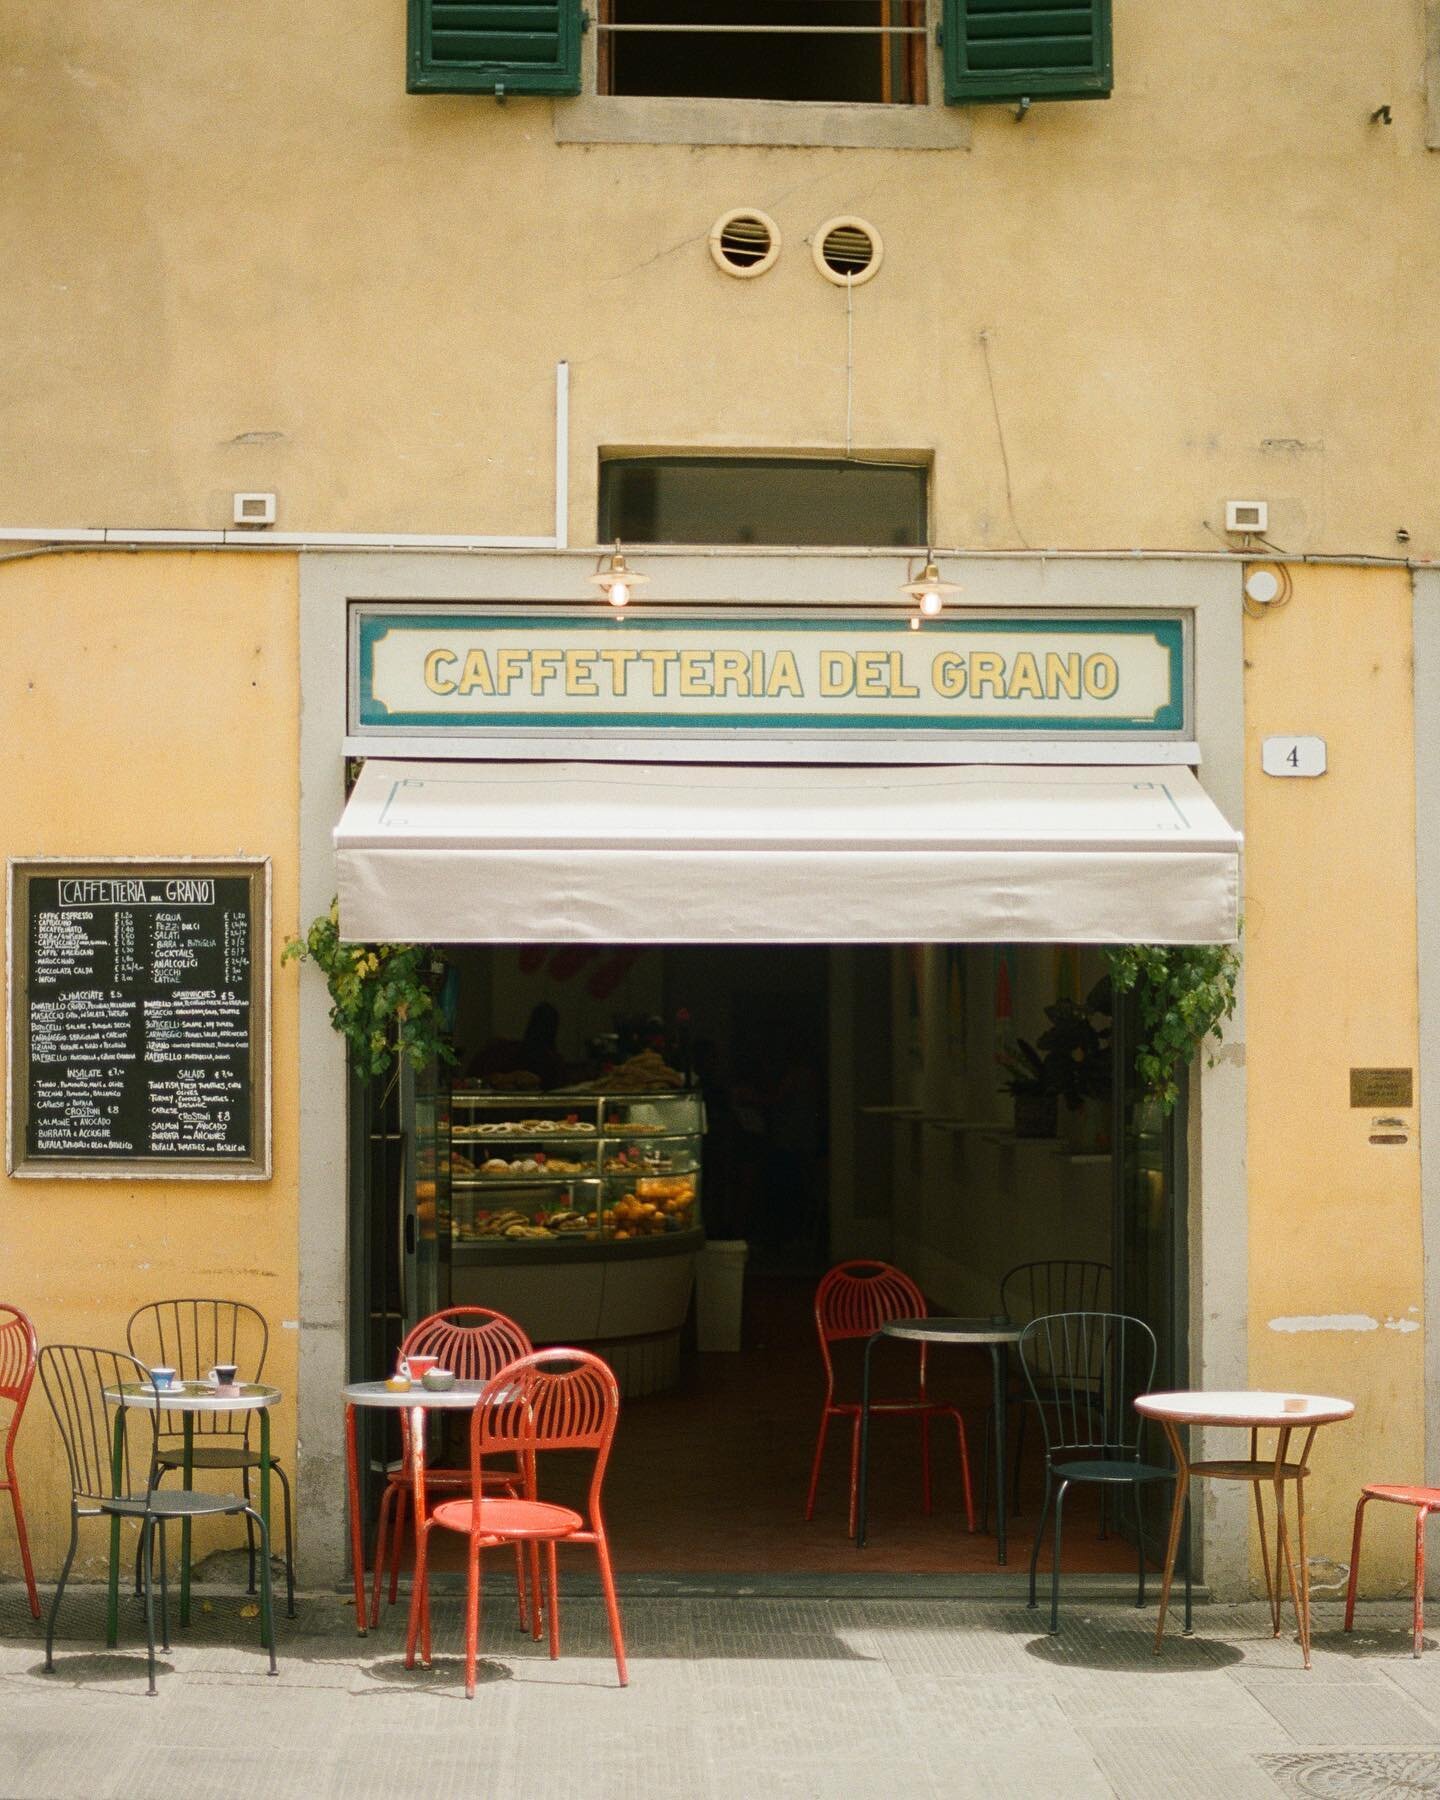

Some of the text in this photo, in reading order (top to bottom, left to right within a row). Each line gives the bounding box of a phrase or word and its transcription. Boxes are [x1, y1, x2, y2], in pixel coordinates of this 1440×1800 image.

[424, 648, 1118, 700] CAFFETTERIA DEL GRANO
[1286, 746, 1299, 768] 4
[166, 880, 209, 903] GRANO
[61, 912, 93, 920] ESPRESSO
[155, 913, 181, 921] ACQUA
[153, 931, 179, 940] SALATI
[157, 940, 176, 949] BIRRA
[155, 949, 194, 959] COCKTAILS
[154, 958, 197, 969] ANALCOLICI
[37, 967, 71, 976] CIOCCOLATA
[154, 967, 181, 977] SUCCHI
[172, 990, 216, 999] SANDWICHES
[31, 1011, 64, 1020] MASACCIO
[67, 1068, 102, 1078] INSALATE
[177, 1070, 205, 1079] SALADS
[65, 1106, 100, 1116] CROSTONI
[177, 1112, 210, 1121] CROSTONI
[38, 1117, 71, 1126] SALMONE
[80, 1117, 111, 1126] AVOCADO
[151, 1122, 179, 1131] SALMON
[195, 1121, 227, 1131] AVOCADO
[39, 1129, 71, 1137] BURRATA
[79, 1129, 110, 1138] ACCIUGHE
[151, 1131, 179, 1140] BURRATA
